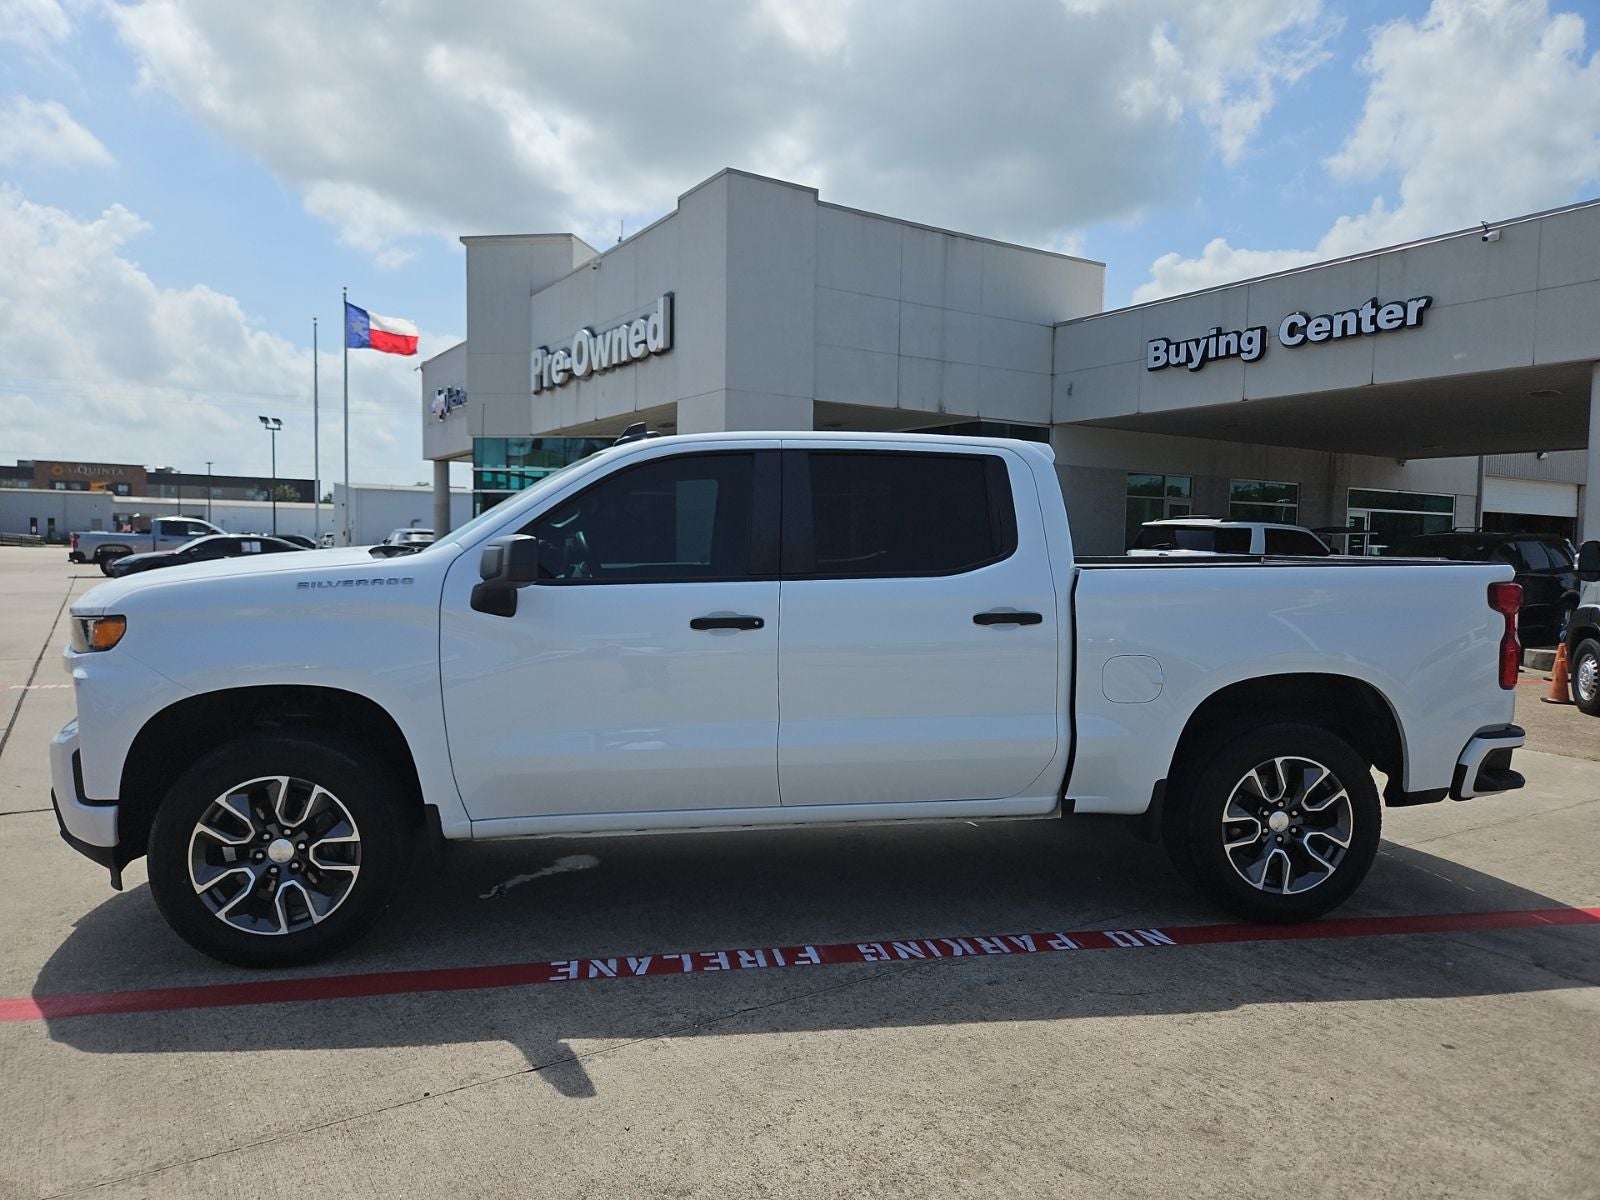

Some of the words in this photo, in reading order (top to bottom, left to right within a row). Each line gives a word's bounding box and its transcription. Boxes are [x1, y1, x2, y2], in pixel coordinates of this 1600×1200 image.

[530, 291, 675, 395] Pre-Owned
[1147, 325, 1267, 372] Buying
[1278, 295, 1434, 348] Center
[296, 577, 415, 590] SILVERADO
[856, 932, 1083, 961] PARKING
[1101, 928, 1177, 948] NO
